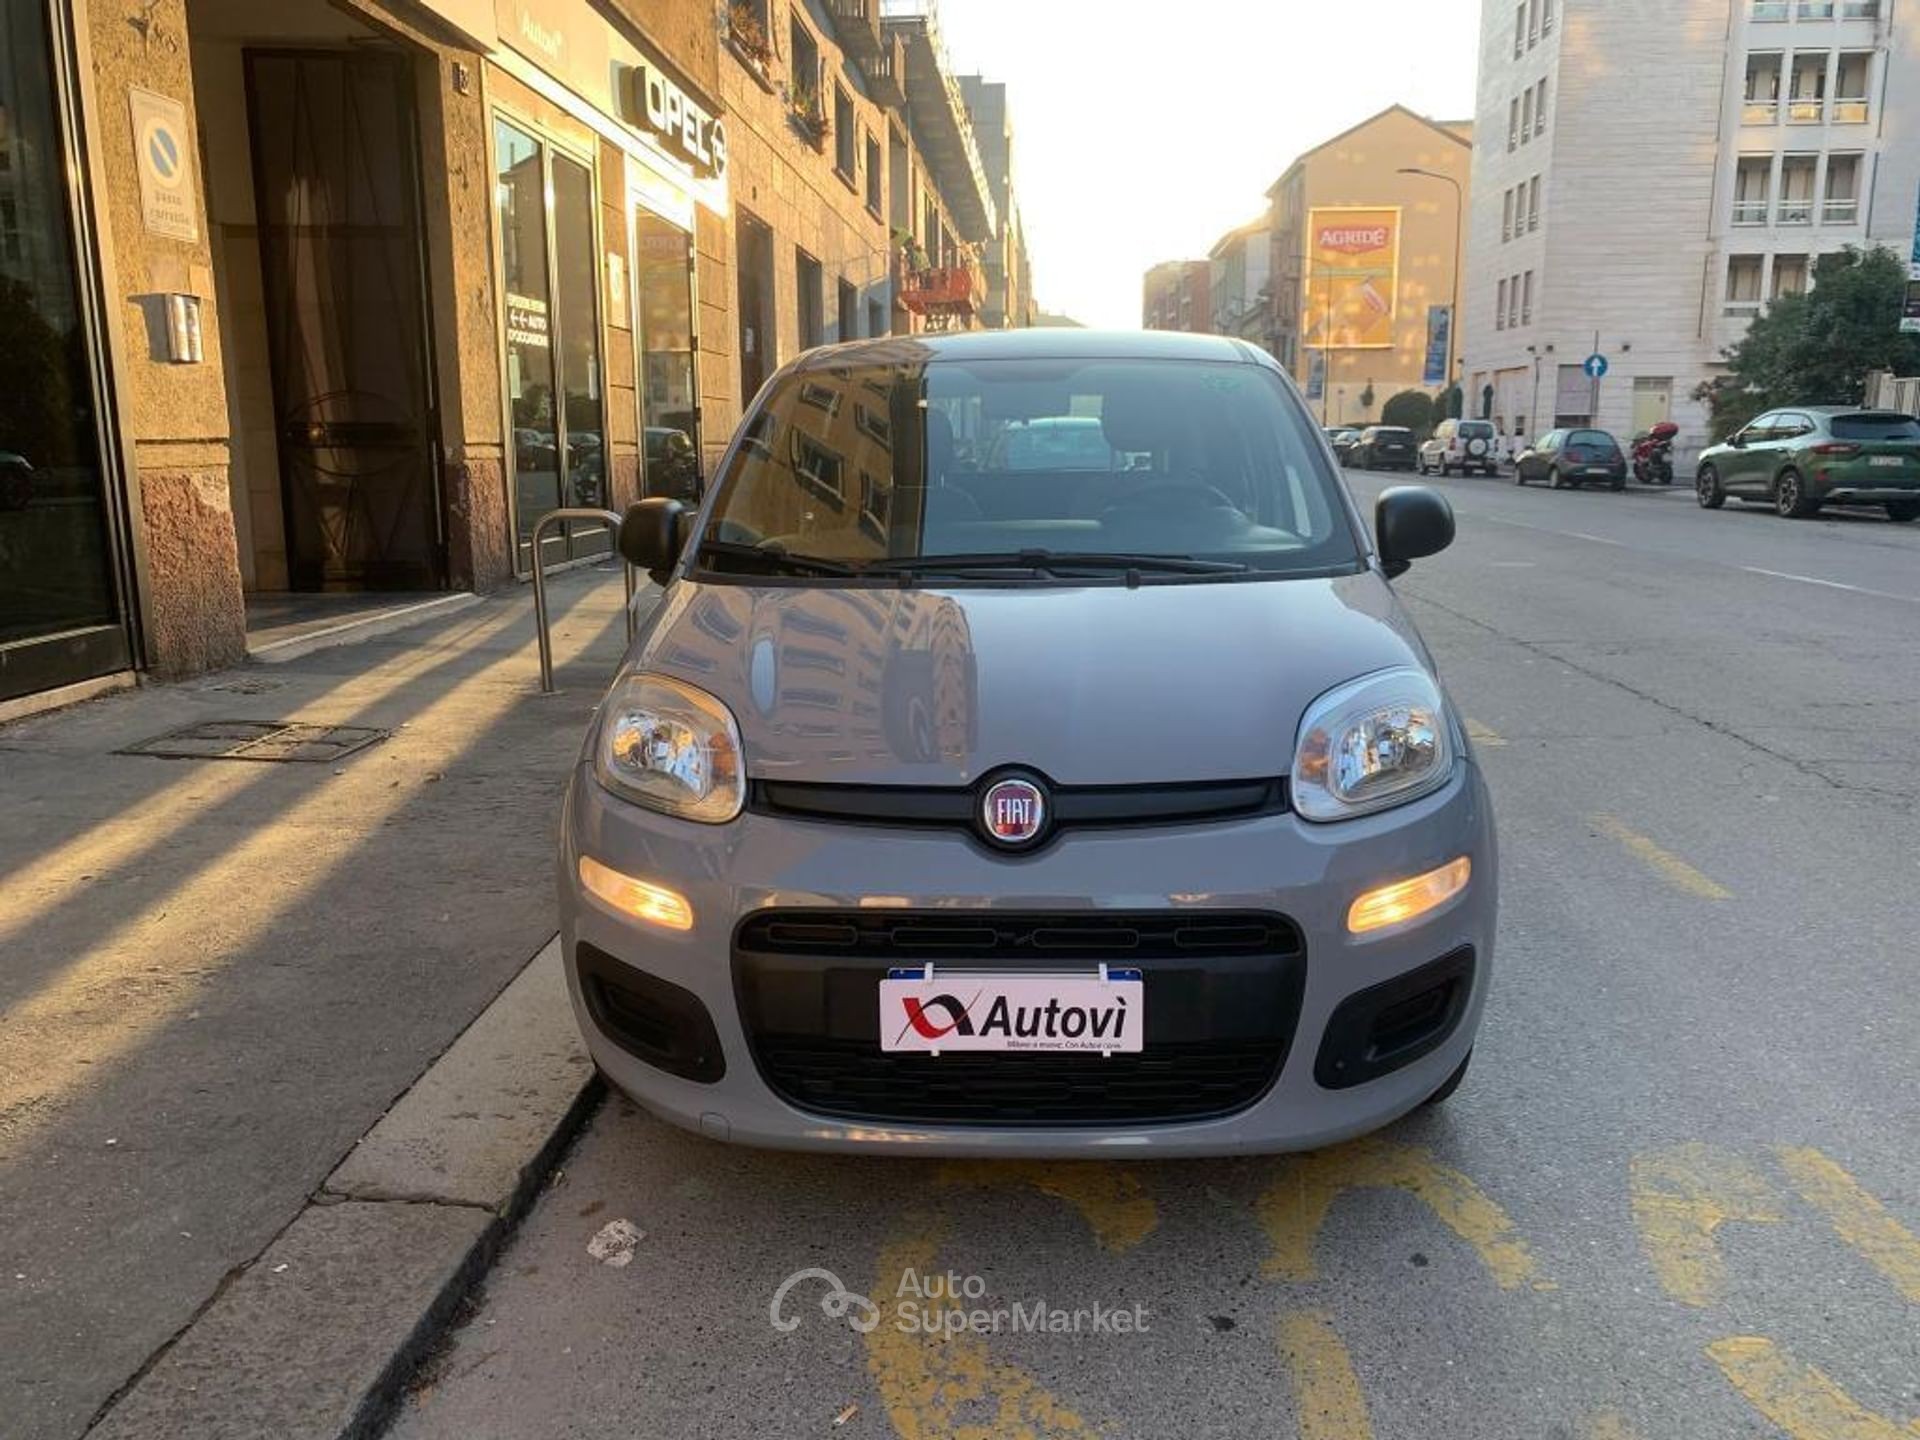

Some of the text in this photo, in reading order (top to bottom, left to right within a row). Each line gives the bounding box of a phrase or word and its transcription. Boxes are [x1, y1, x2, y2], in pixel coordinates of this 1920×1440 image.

[643, 66, 712, 167] OPEL
[997, 798, 1033, 825] FIAT
[979, 995, 1128, 1038] Autovì
